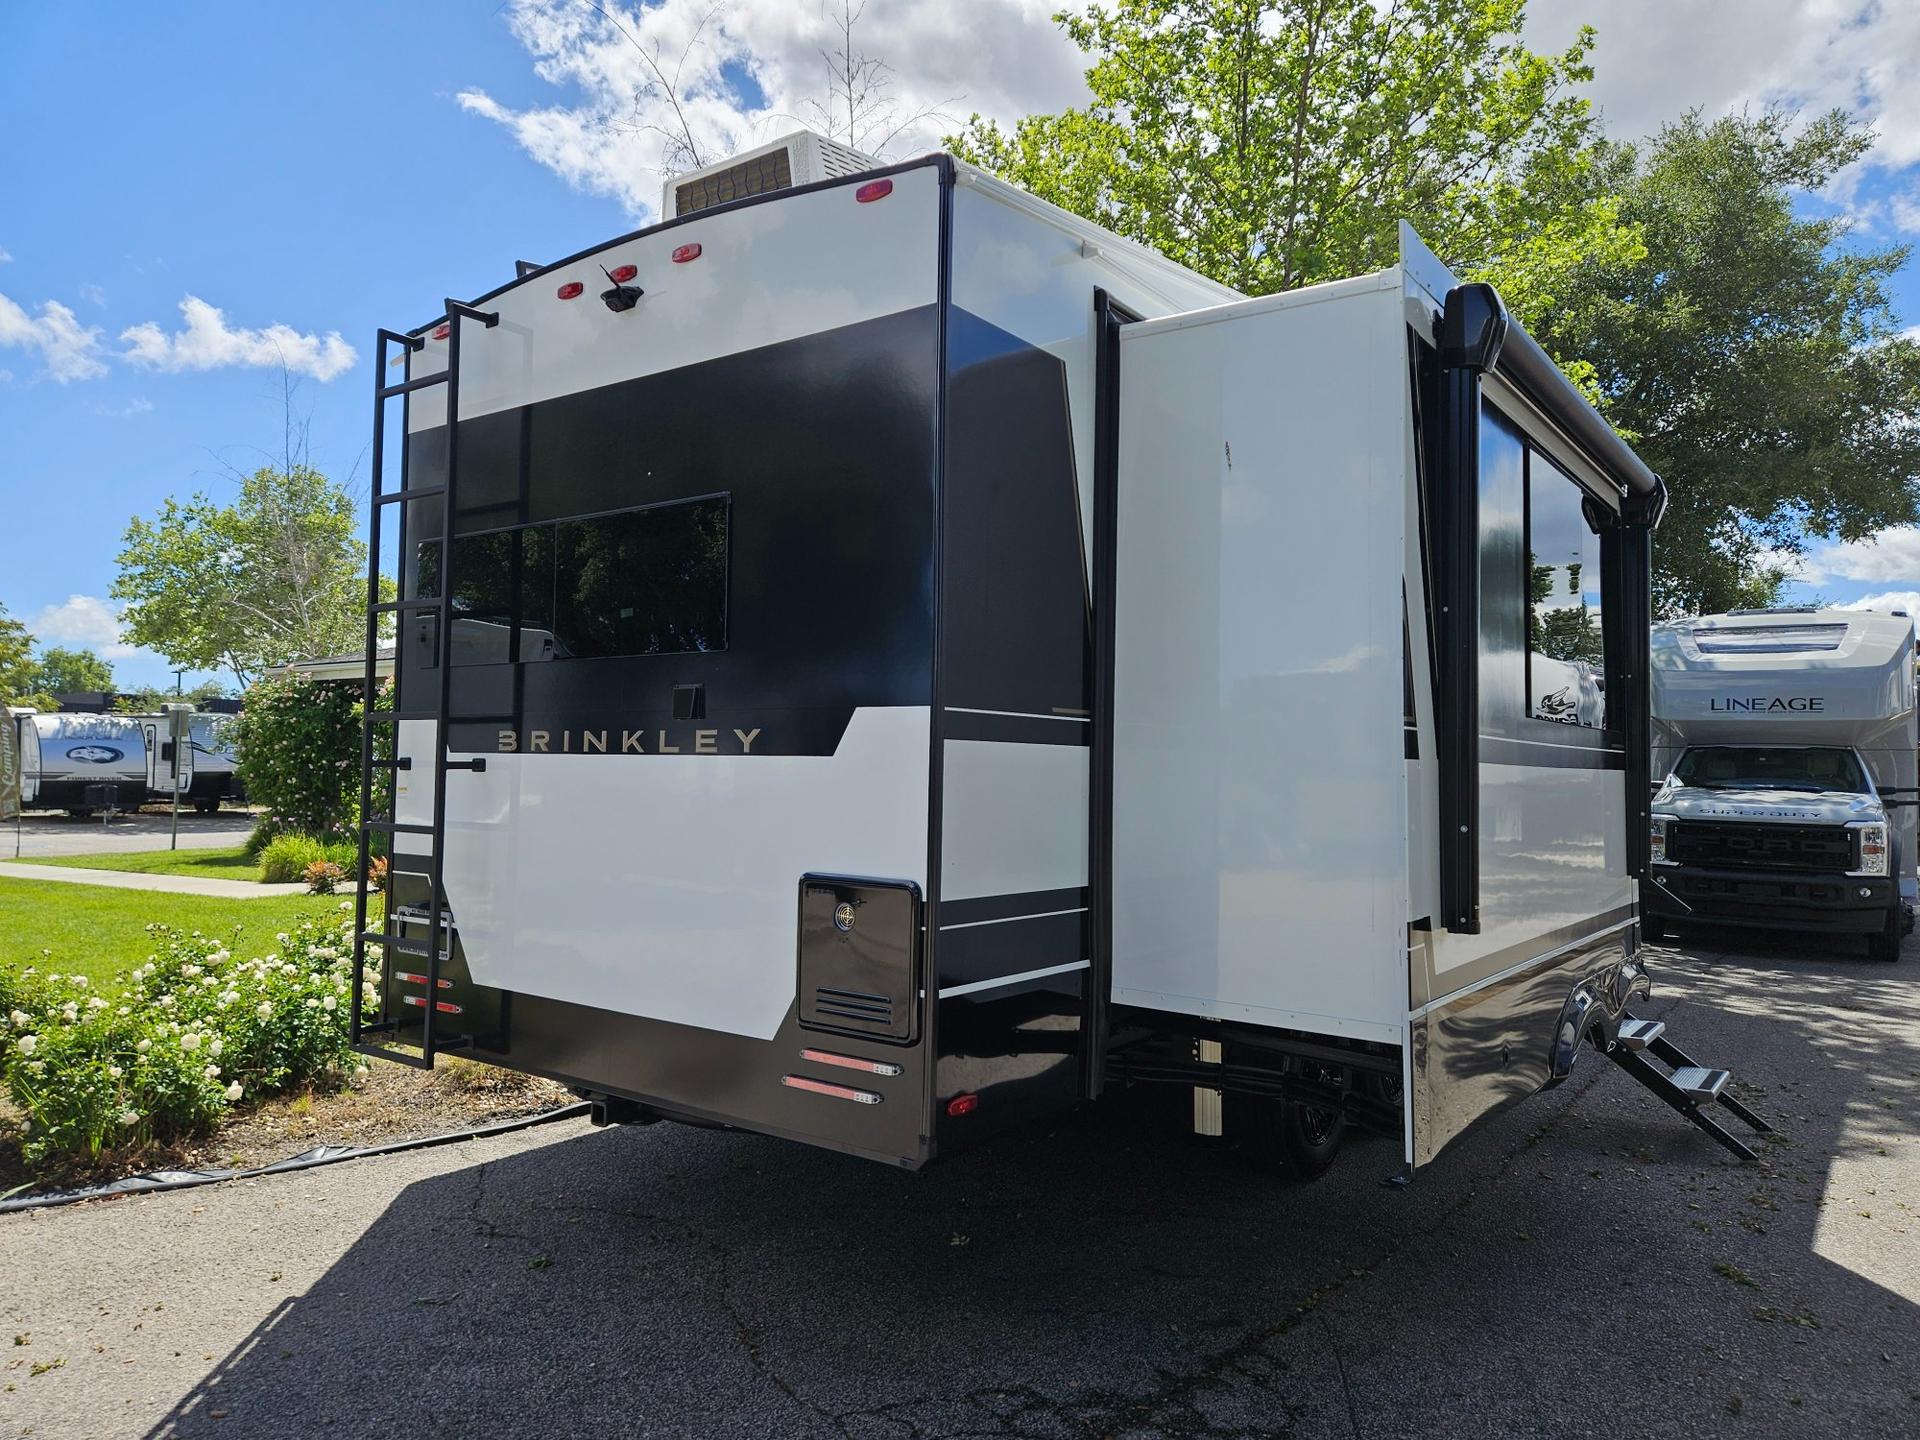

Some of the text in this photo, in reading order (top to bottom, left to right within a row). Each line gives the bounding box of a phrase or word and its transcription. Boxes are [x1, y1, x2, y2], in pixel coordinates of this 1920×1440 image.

[1711, 697, 1825, 711] LINEAGE
[498, 729, 761, 753] BRINKLEY
[1, 723, 15, 786] Camping
[1699, 808, 1765, 817] SUPER
